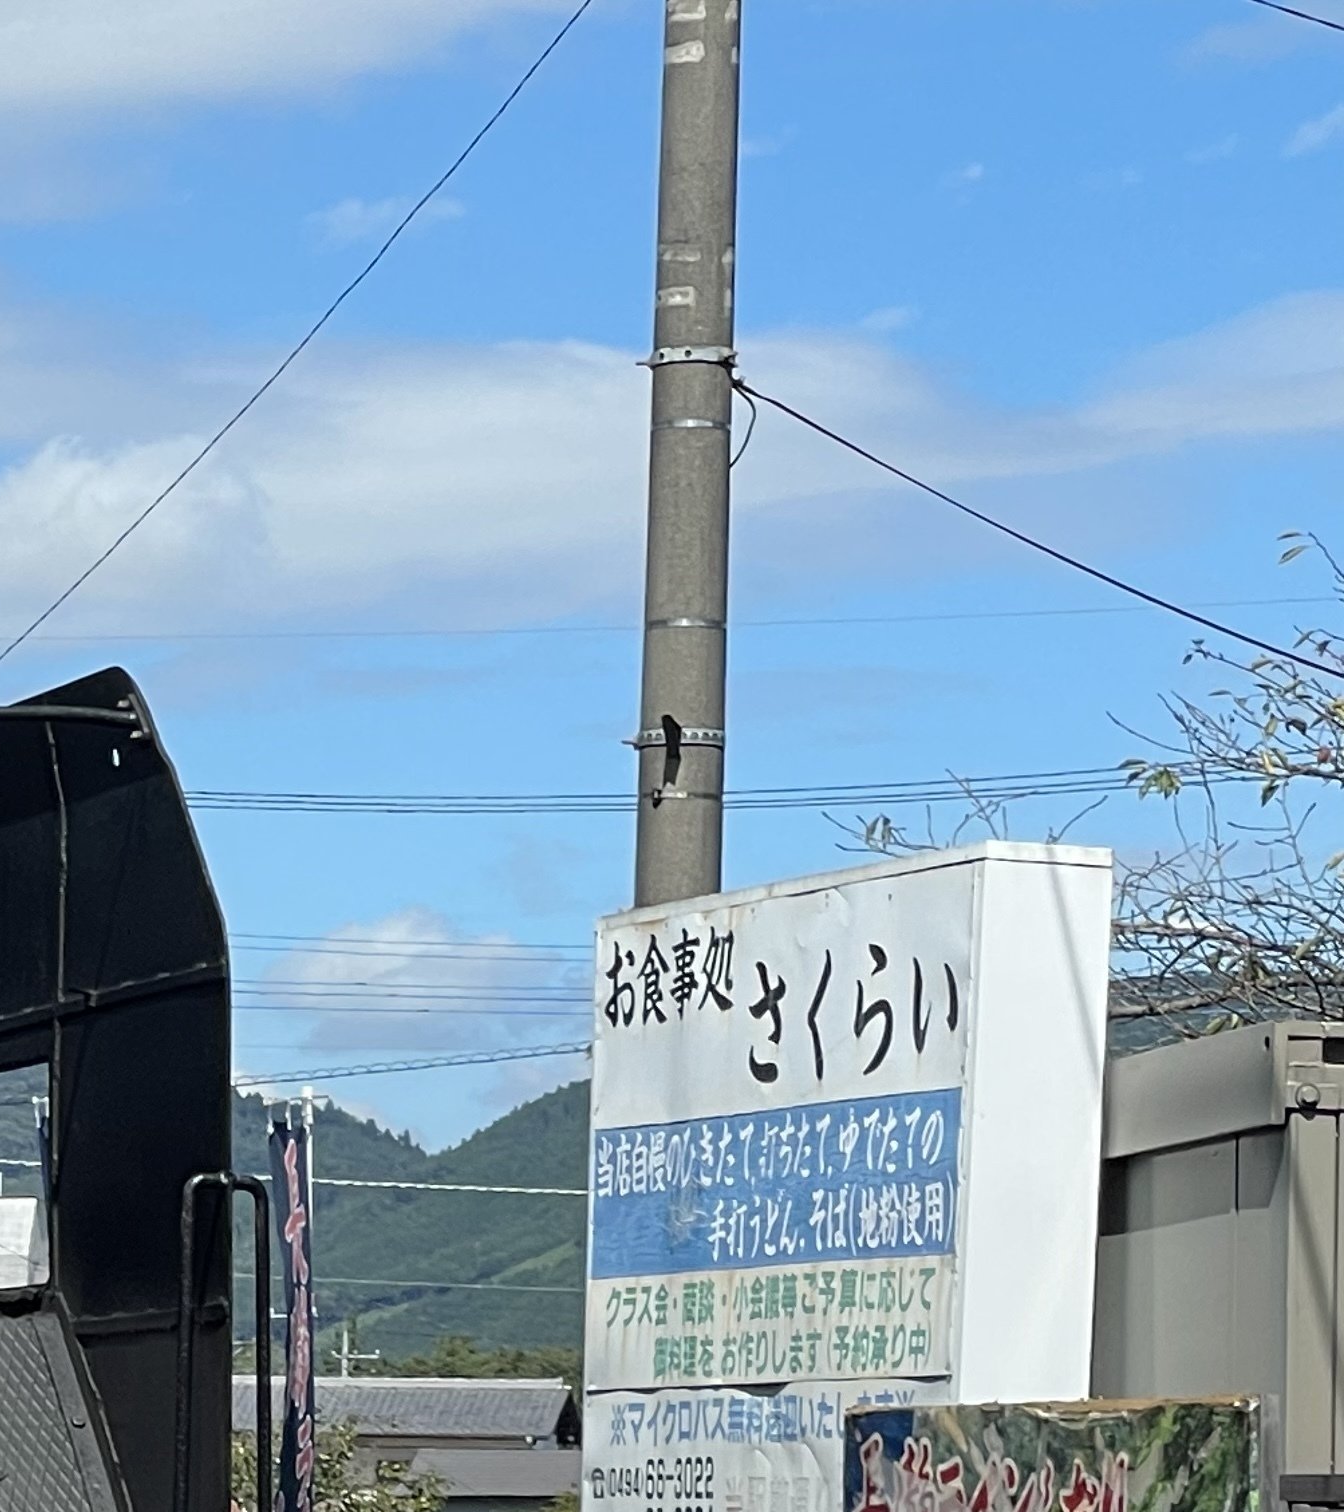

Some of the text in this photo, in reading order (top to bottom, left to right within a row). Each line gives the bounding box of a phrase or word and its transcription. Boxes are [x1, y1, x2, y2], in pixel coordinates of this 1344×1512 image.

[605, 926, 959, 1083] お食事処 さくらい
